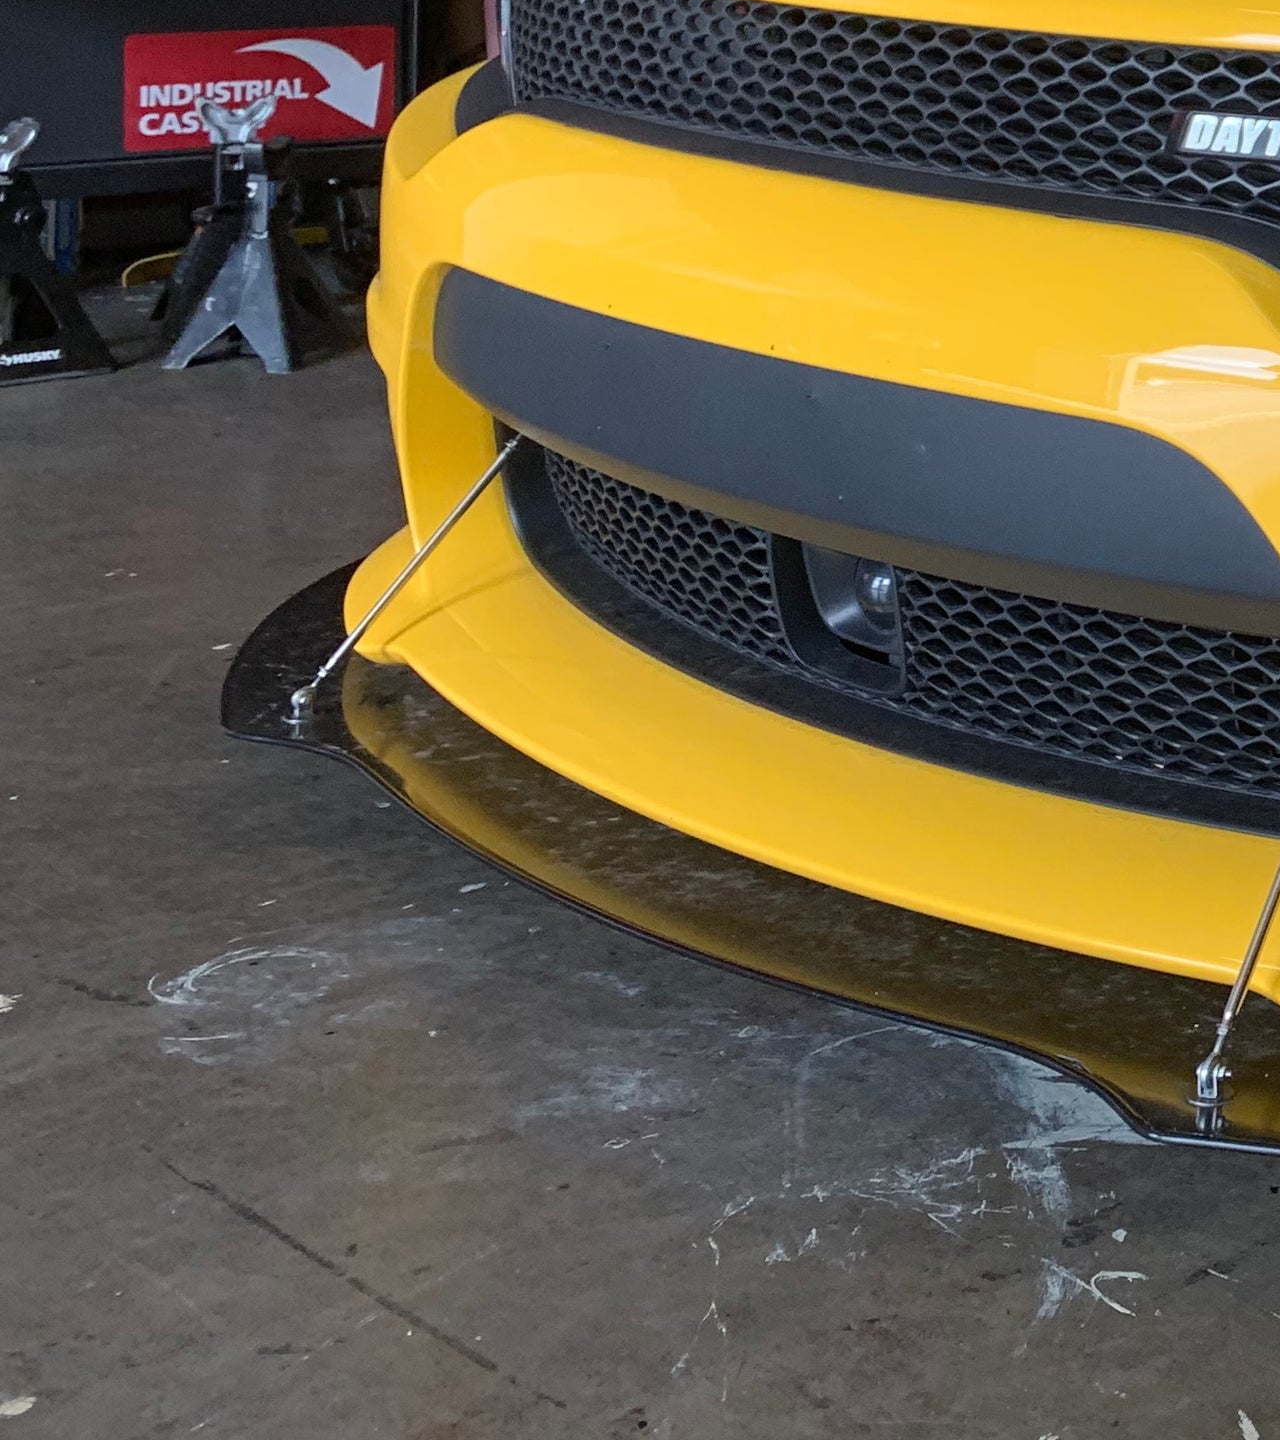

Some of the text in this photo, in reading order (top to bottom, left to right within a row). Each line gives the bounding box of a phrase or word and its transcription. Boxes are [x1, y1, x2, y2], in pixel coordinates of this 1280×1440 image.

[139, 78, 309, 107] INDUSTRIAL
[138, 112, 207, 136] CAS
[12, 349, 61, 364] HUSKY
